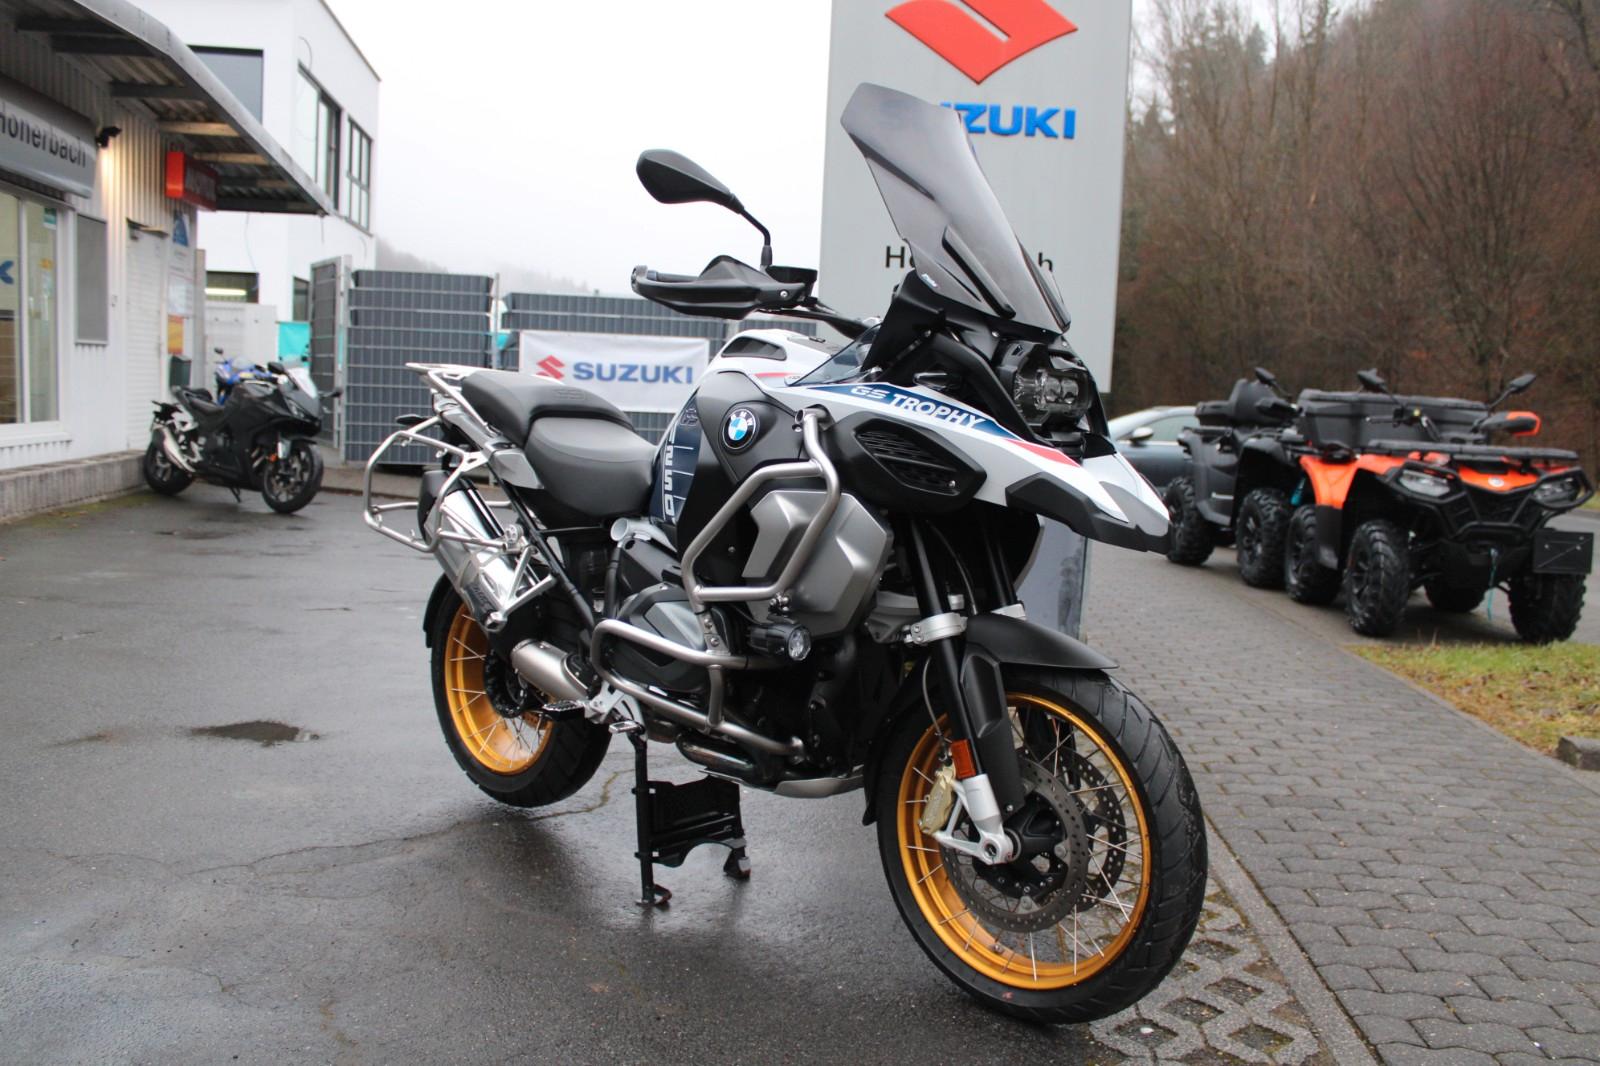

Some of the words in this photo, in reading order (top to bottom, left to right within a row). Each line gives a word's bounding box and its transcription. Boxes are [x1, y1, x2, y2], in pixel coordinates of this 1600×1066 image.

[939, 101, 1076, 140] ZUKI
[573, 361, 693, 384] SUZUKI
[850, 386, 890, 399] GS
[890, 393, 986, 428] TROPHY
